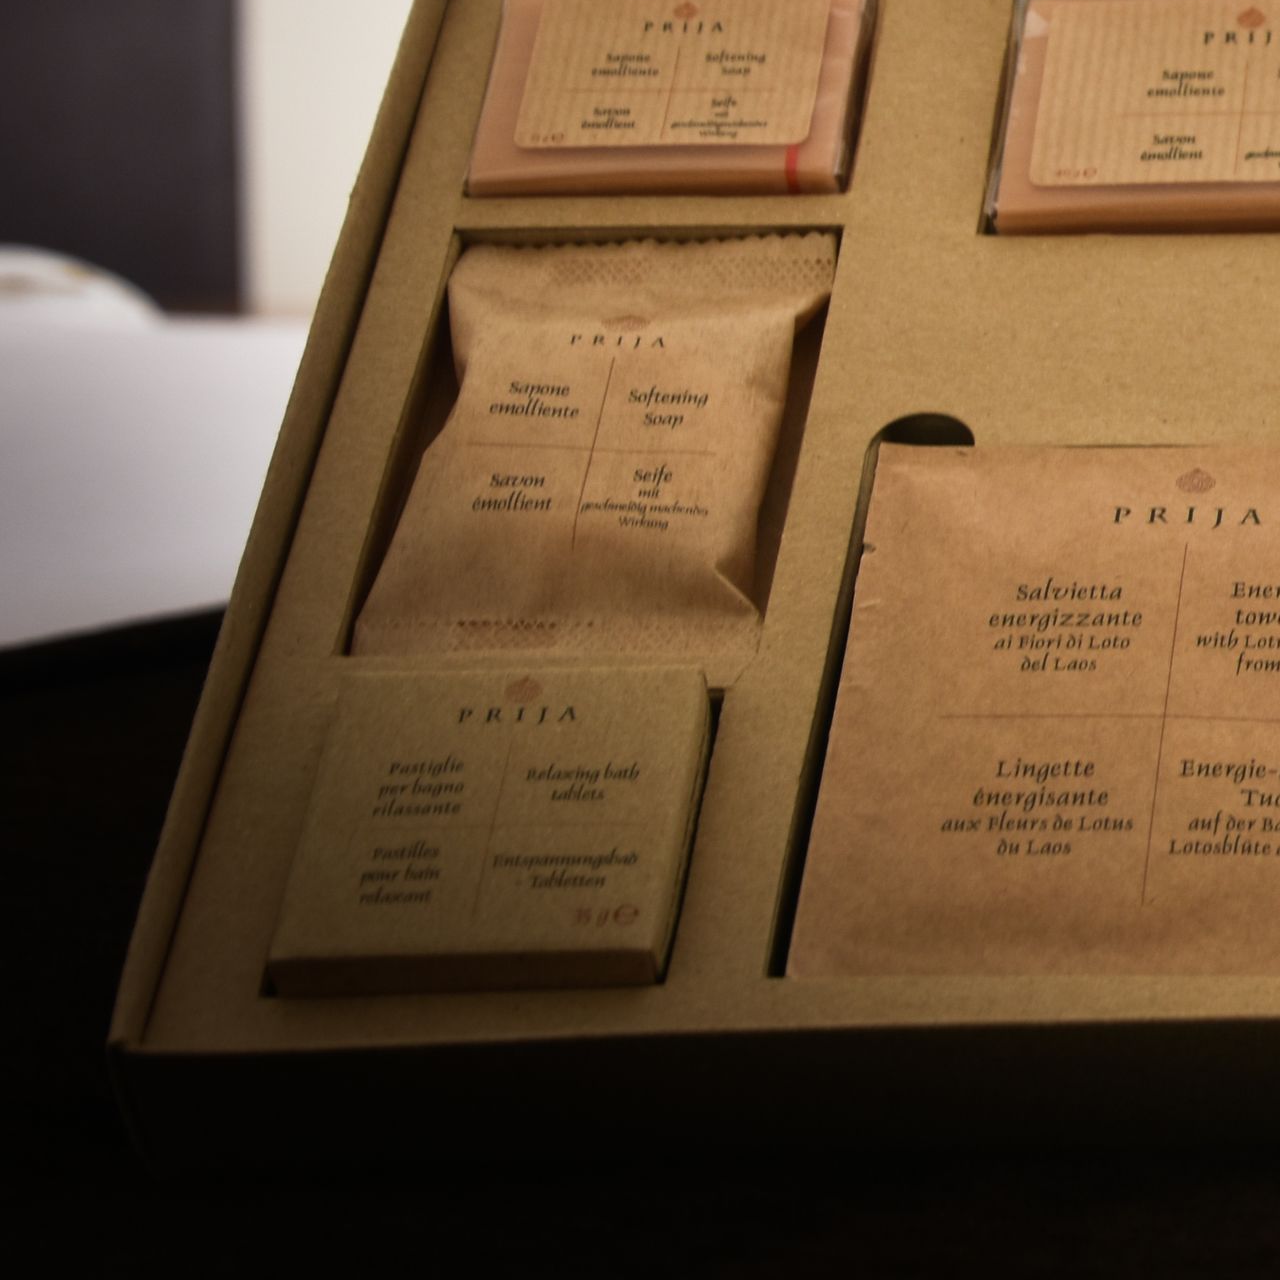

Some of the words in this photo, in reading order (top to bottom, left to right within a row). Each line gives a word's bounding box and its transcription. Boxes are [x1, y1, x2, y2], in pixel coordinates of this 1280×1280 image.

[644, 20, 723, 35] PRIJA
[570, 333, 666, 349] PRIJA
[508, 380, 571, 399] Sapone
[628, 385, 709, 409] Softening
[489, 397, 580, 419] emolliente
[489, 472, 546, 489] Savon
[632, 463, 673, 487] Seife
[1113, 505, 1263, 529] PRIJA
[1015, 576, 1123, 602] Salvietta
[988, 607, 1143, 633] energizzante
[993, 634, 1013, 650] ai
[1016, 633, 1063, 650] Fiori
[1065, 632, 1084, 650] di
[1087, 634, 1131, 650] Loto
[1195, 629, 1240, 650] with
[1020, 652, 1050, 673] del
[1053, 655, 1098, 673] Laos
[458, 706, 577, 724] PRIJA
[995, 757, 1096, 783] Lingette
[940, 816, 980, 833] aux
[986, 810, 1048, 832] Fleurs
[1053, 814, 1075, 832] de
[1079, 815, 1135, 832] Lotus
[1188, 809, 1223, 836] auf
[1225, 815, 1256, 834] der
[996, 838, 1020, 856] du
[1026, 839, 1072, 856] Laos
[1168, 833, 1272, 857] Lotosblüte
